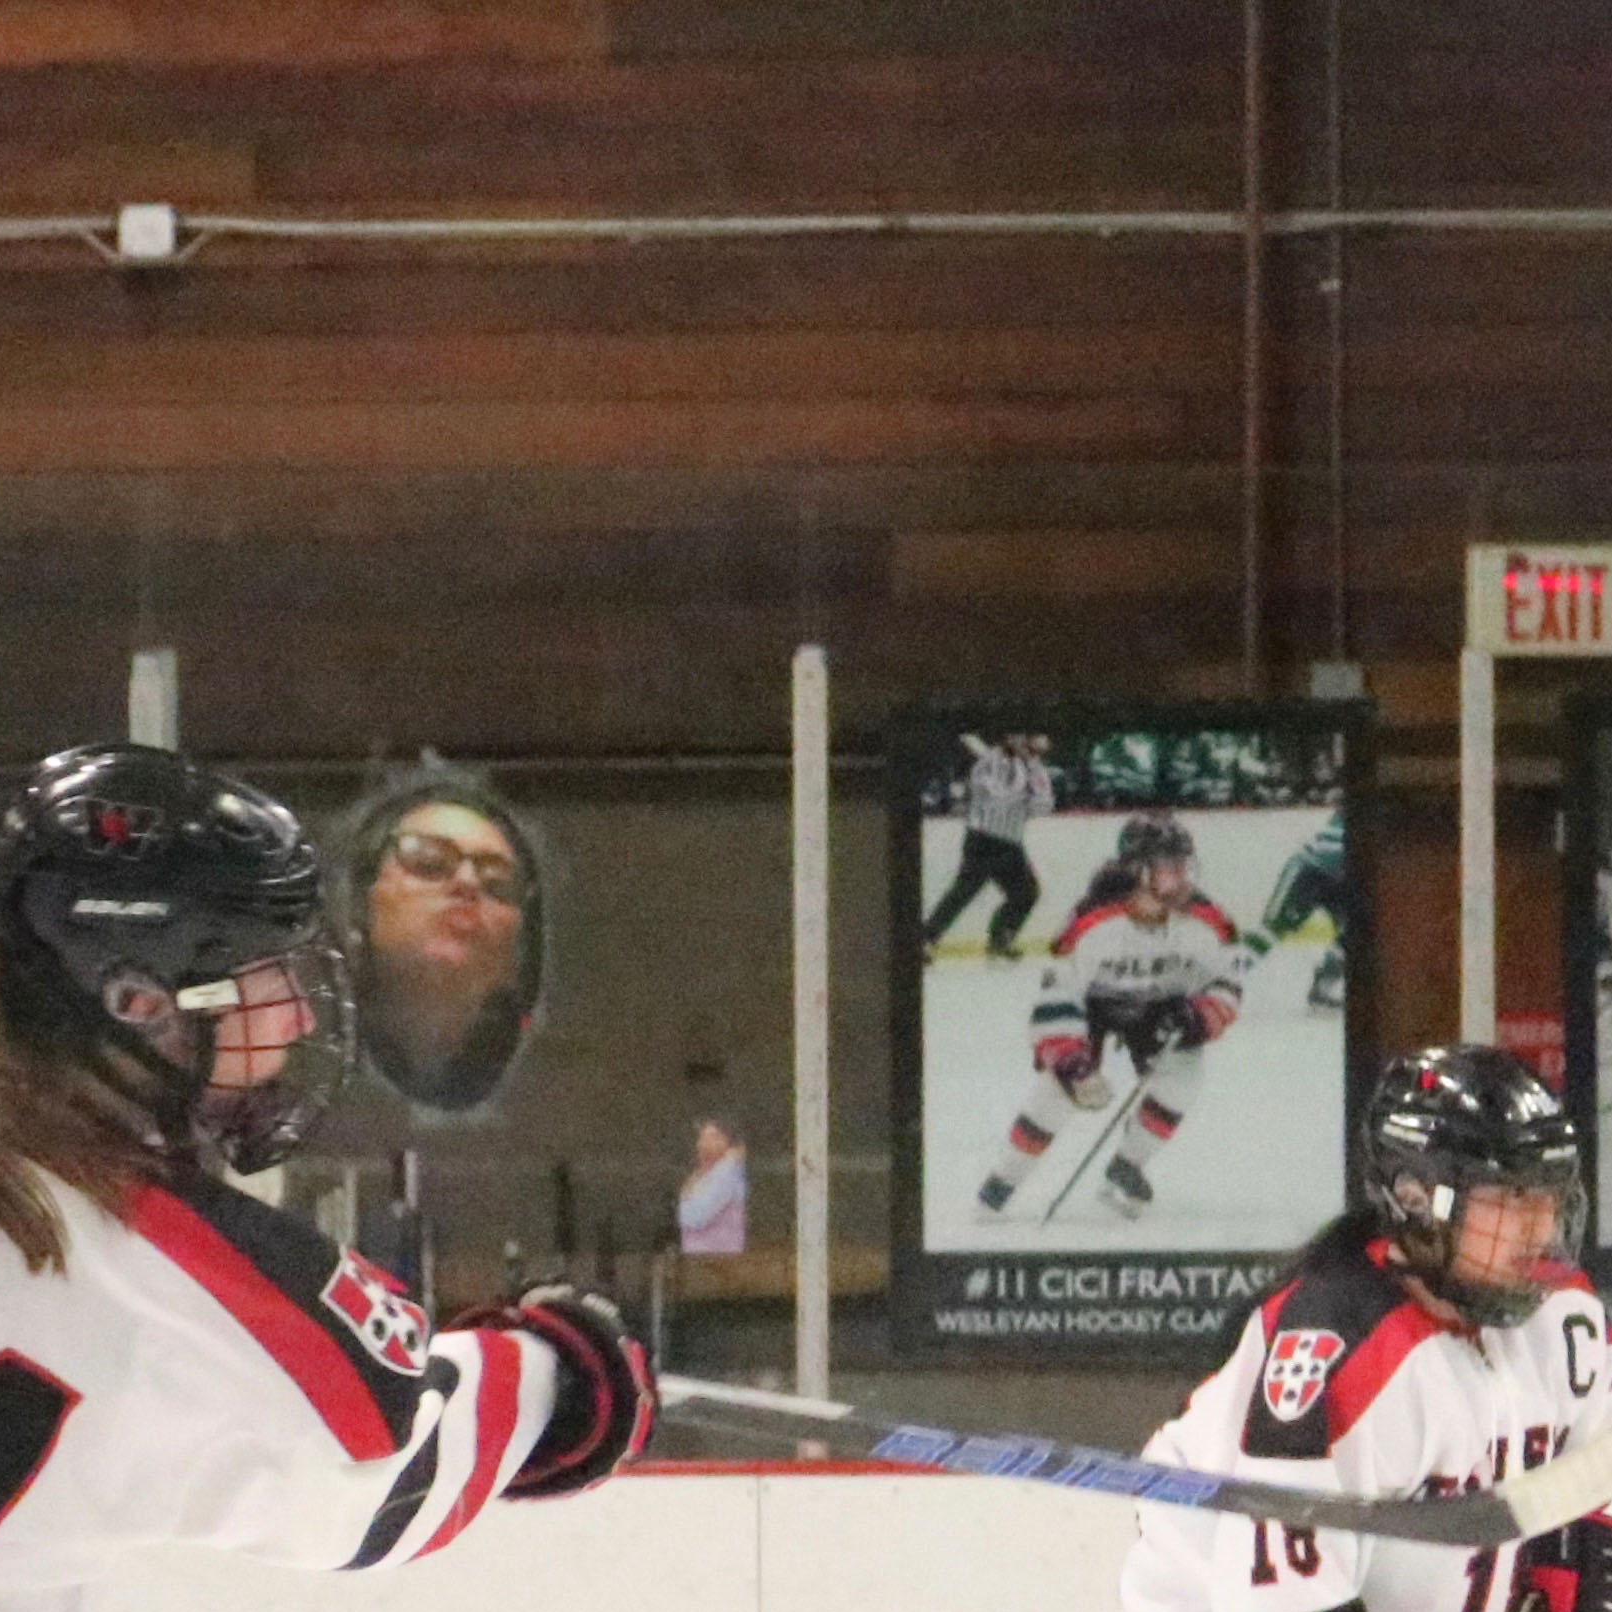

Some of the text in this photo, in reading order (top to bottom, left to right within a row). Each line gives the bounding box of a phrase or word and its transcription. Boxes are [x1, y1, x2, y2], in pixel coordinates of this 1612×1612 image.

[1502, 554, 1609, 640] EXIT
[965, 1267, 1026, 1298] #11
[1038, 1267, 1110, 1298] CICI
[935, 1308, 1061, 1334] WESLEYAN
[1066, 1308, 1164, 1333] HOCKEY
[1562, 1313, 1598, 1398] C
